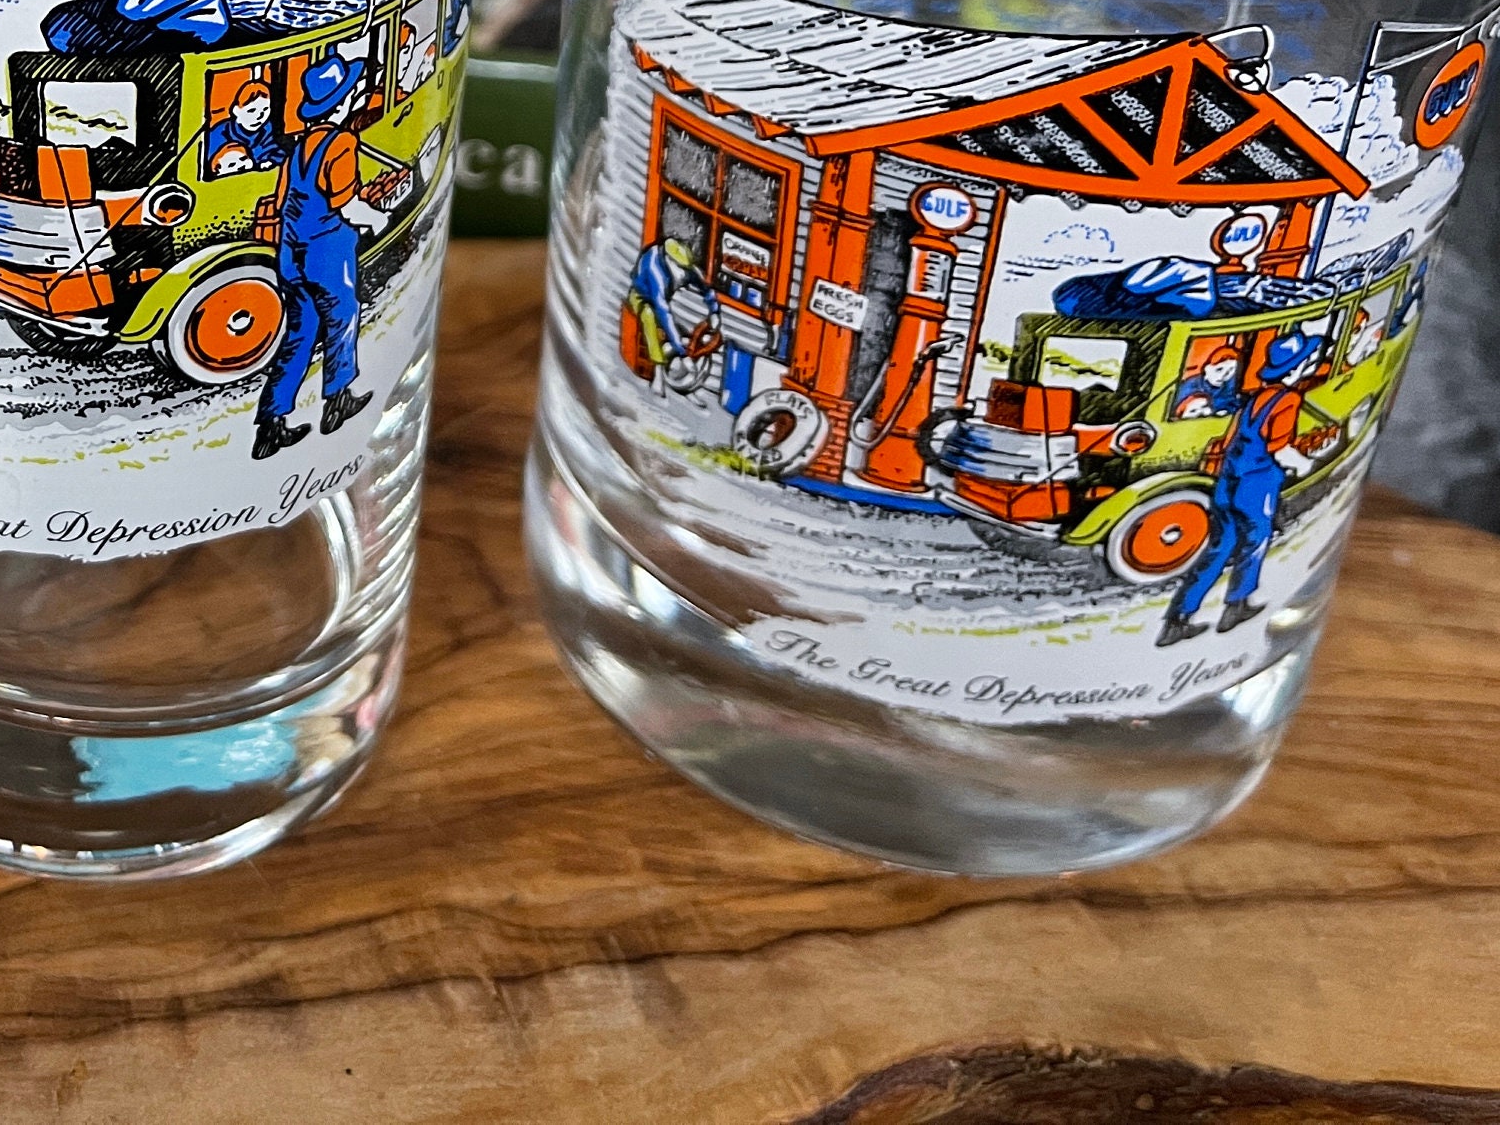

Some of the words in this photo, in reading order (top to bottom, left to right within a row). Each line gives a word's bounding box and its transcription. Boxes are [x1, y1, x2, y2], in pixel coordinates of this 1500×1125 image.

[920, 191, 971, 218] GULF
[811, 297, 854, 323] EGGS
[816, 283, 864, 310] FRESH
[763, 391, 814, 420] FLATS
[45, 502, 263, 555] Depression
[268, 454, 367, 525] Years
[764, 628, 840, 670] The
[848, 657, 951, 698] Great
[963, 673, 1153, 710] Depression
[1158, 650, 1254, 702] Years
